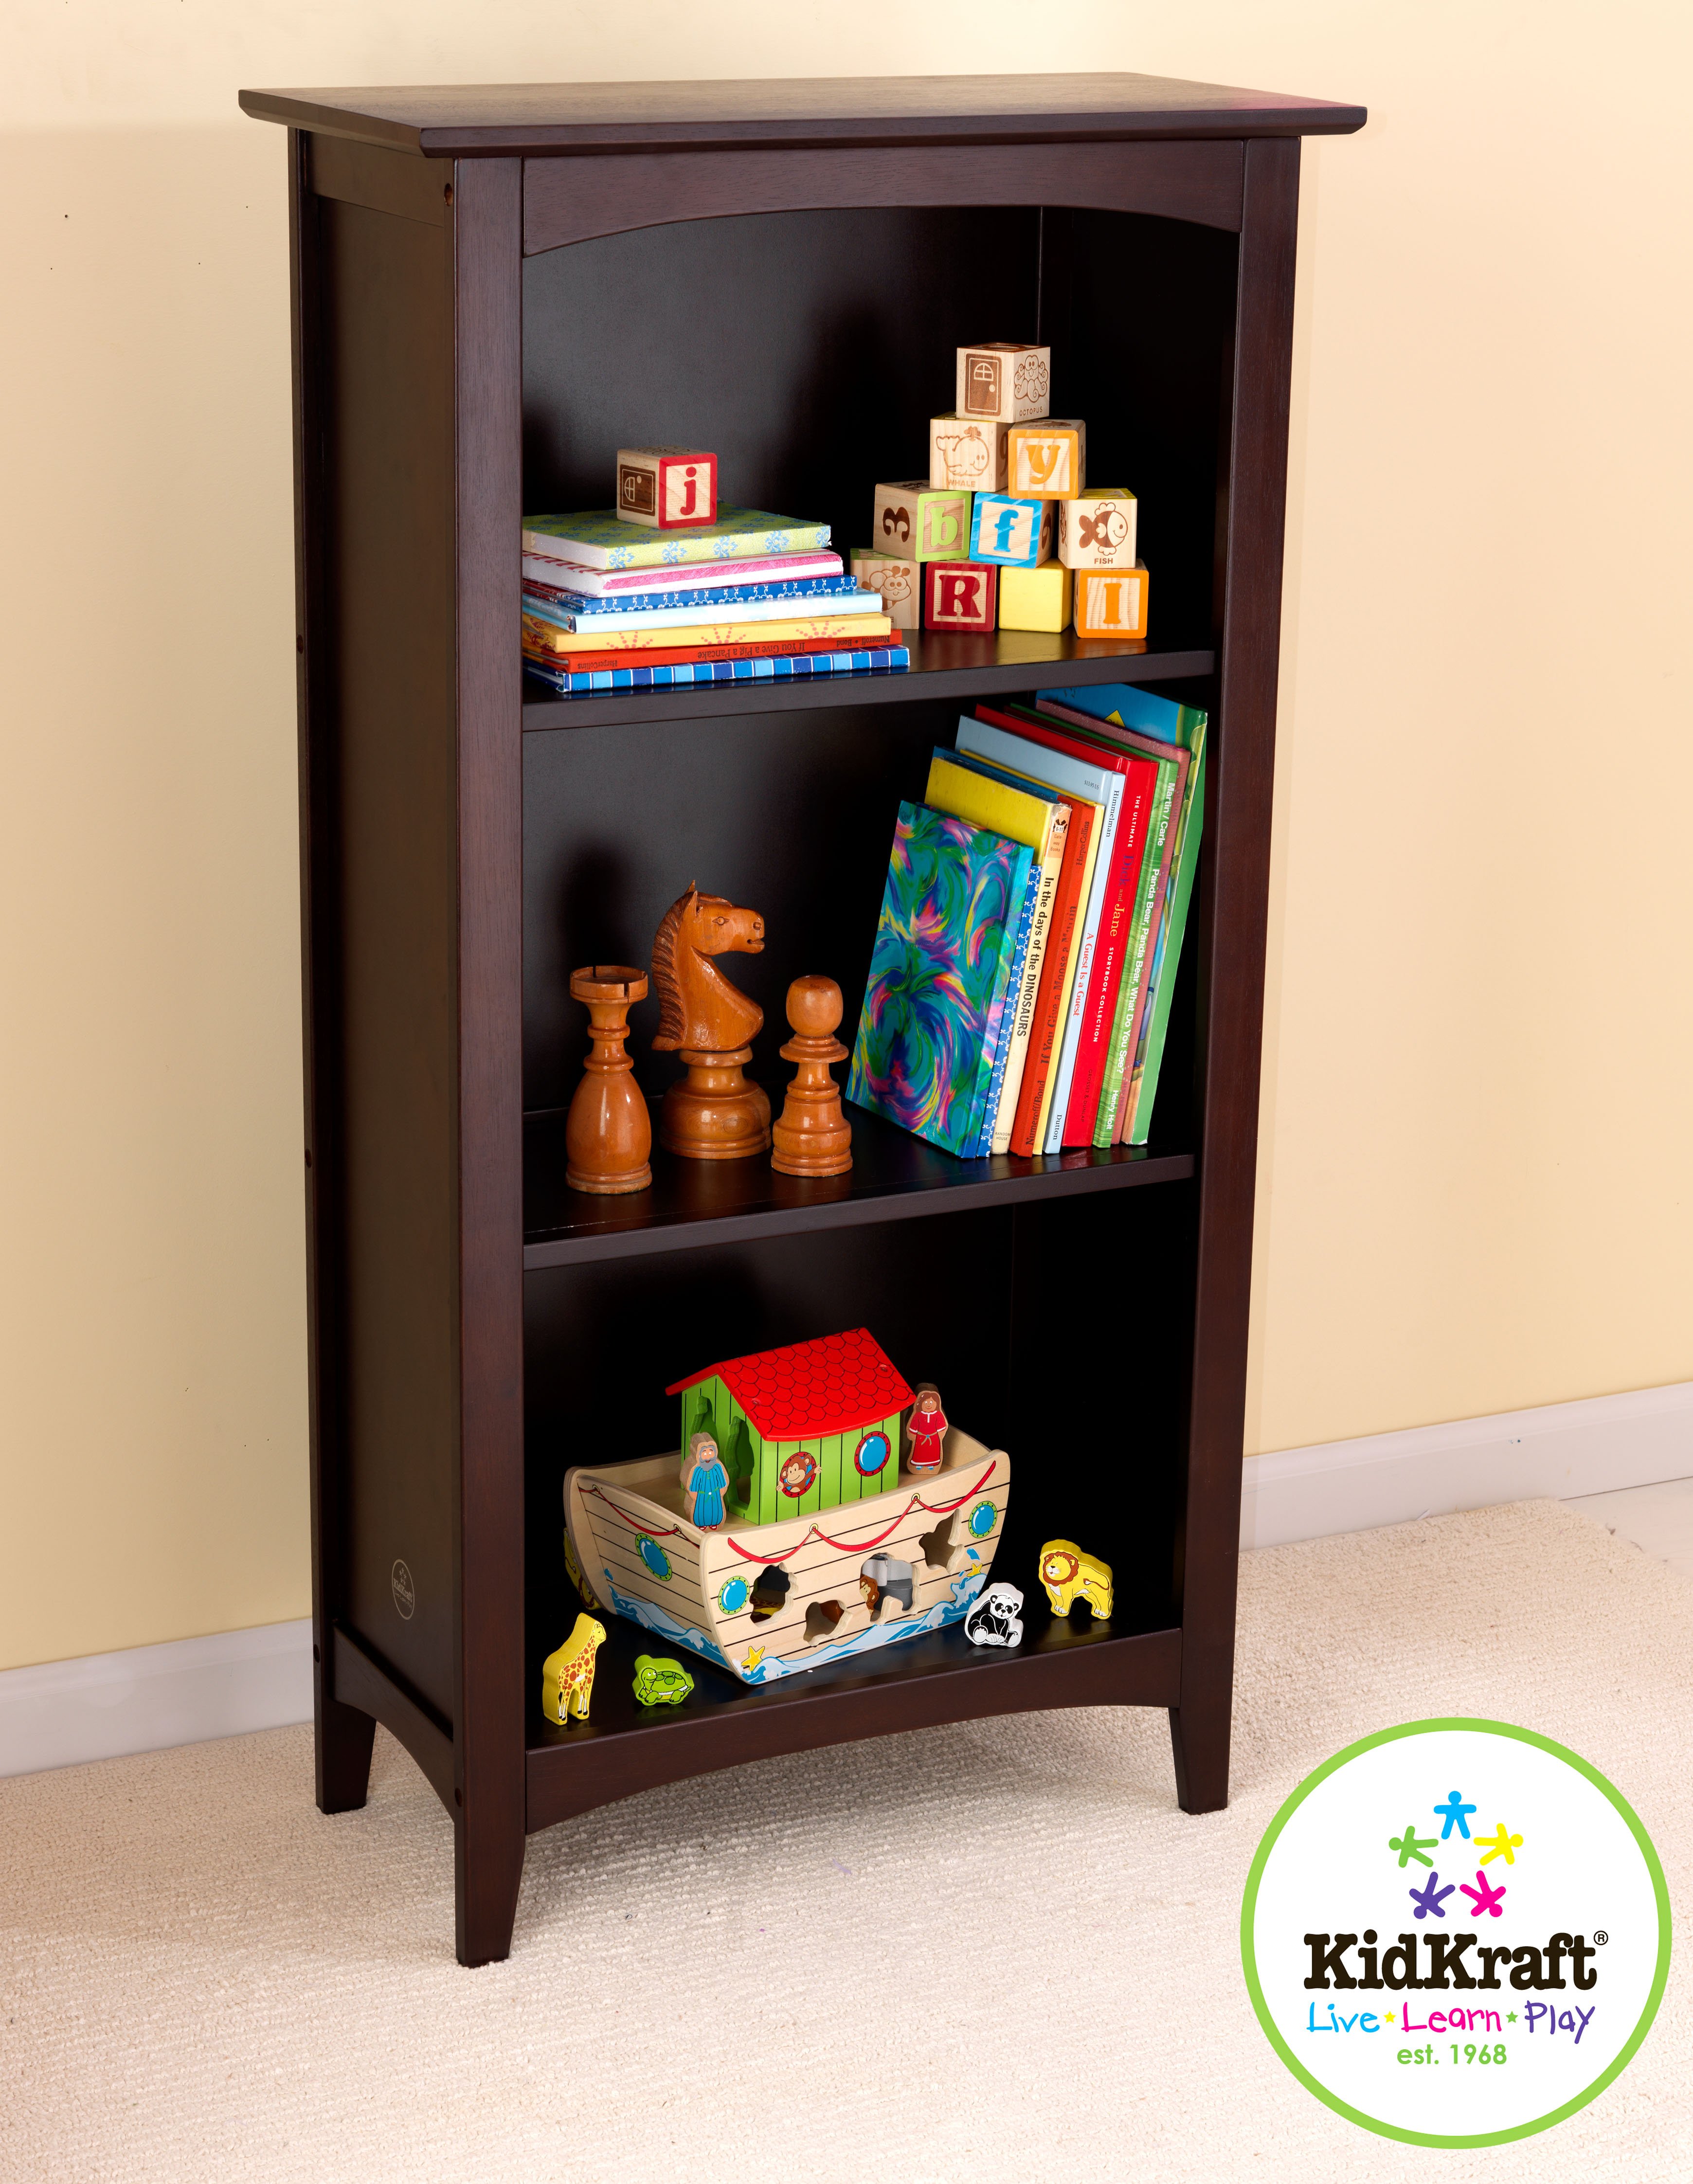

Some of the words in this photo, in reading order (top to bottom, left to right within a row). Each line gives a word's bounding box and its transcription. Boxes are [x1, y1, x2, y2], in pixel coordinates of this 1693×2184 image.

[1019, 406, 1043, 416] OCTOPUS
[1025, 445, 1061, 485] y
[680, 467, 697, 516] j
[948, 479, 976, 487] WHALE
[930, 506, 958, 547] b
[994, 509, 1019, 552] f
[937, 574, 982, 618] R
[698, 650, 730, 660] Pancake
[739, 646, 753, 656] Pig
[762, 645, 779, 654] Give
[782, 644, 797, 652] You
[798, 642, 805, 651] If
[836, 639, 852, 648] Bond
[577, 660, 617, 670] HarperCollins
[1163, 782, 1175, 813] Martin
[1106, 790, 1119, 837] Himmelman
[1127, 812, 1138, 848] ULTIMATE
[1157, 821, 1168, 846] Carle
[1076, 821, 1090, 866] HarperCollins
[1044, 877, 1054, 887] In
[1119, 855, 1134, 886] Dick
[1148, 868, 1160, 899] Panda
[1040, 890, 1051, 907] the
[1035, 911, 1047, 936] days
[1110, 903, 1125, 937] Jane
[1142, 902, 1154, 925] Bear,
[1032, 939, 1041, 950] of
[1137, 928, 1149, 958] Panda
[1028, 954, 1040, 970] the
[1081, 943, 1093, 969] Guest
[1053, 956, 1067, 991] Moose
[1101, 947, 1114, 992] STORYBOOK
[1131, 960, 1143, 984] Bear,
[1017, 974, 1037, 1037] DINOSAURS
[1073, 991, 1084, 1016] Guest
[1128, 987, 1139, 1012] What
[1047, 1003, 1058, 1028] Give
[1093, 995, 1105, 1042] COLLECTION
[1125, 1014, 1134, 1028] Do
[1043, 1031, 1053, 1051] You
[1121, 1029, 1131, 1047] You
[1040, 1053, 1050, 1064] If
[1117, 1050, 1127, 1074] See?
[1025, 1080, 1045, 1146] Numeroff/Bond
[1108, 1090, 1118, 1113] Henry
[1053, 1114, 1062, 1140] Dutton
